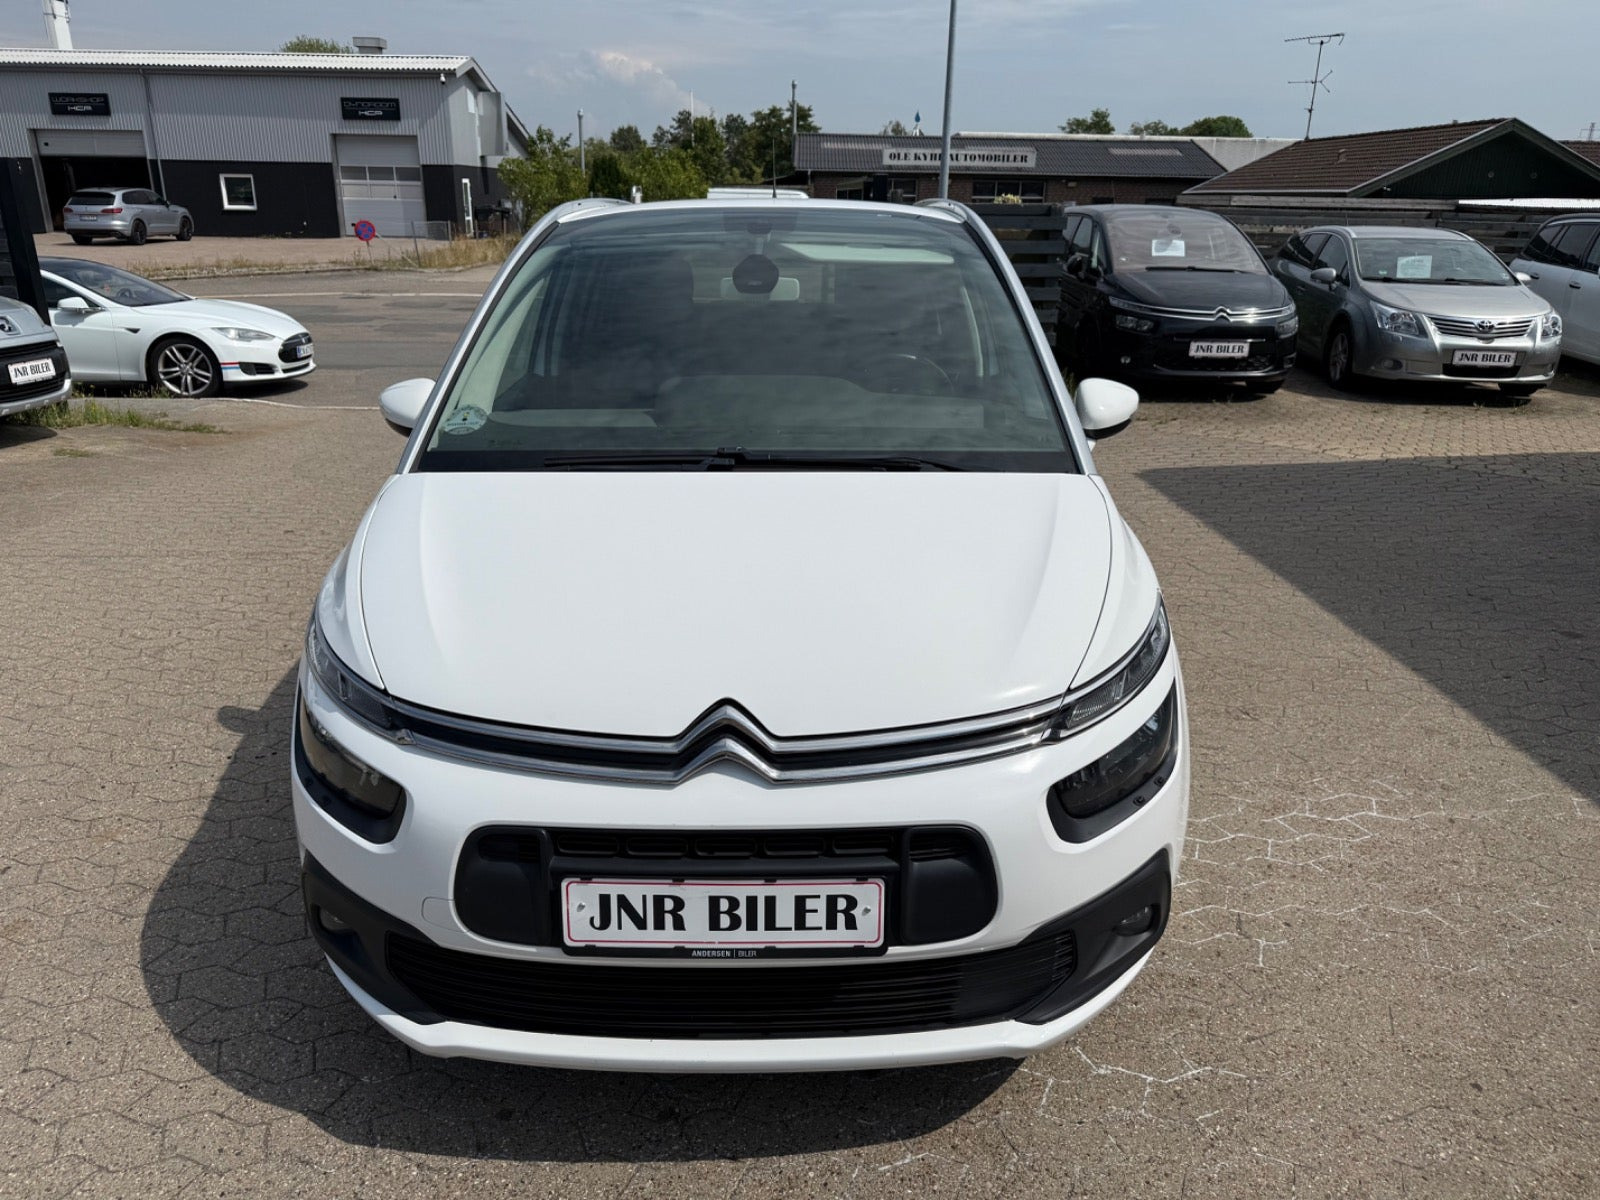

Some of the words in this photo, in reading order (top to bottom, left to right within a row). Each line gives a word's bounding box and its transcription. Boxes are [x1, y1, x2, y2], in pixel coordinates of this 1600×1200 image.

[889, 152, 911, 161] OLE
[949, 153, 1028, 163] AUTOMOBILER
[1194, 344, 1213, 353] JNR
[1216, 344, 1244, 354] BILER
[1459, 352, 1478, 362] JNR
[1481, 353, 1511, 363] BILER
[14, 366, 29, 378] JNR
[30, 362, 51, 375] BILER
[589, 893, 686, 931] JNR
[708, 894, 858, 931] BILER
[738, 950, 757, 958] BILER
